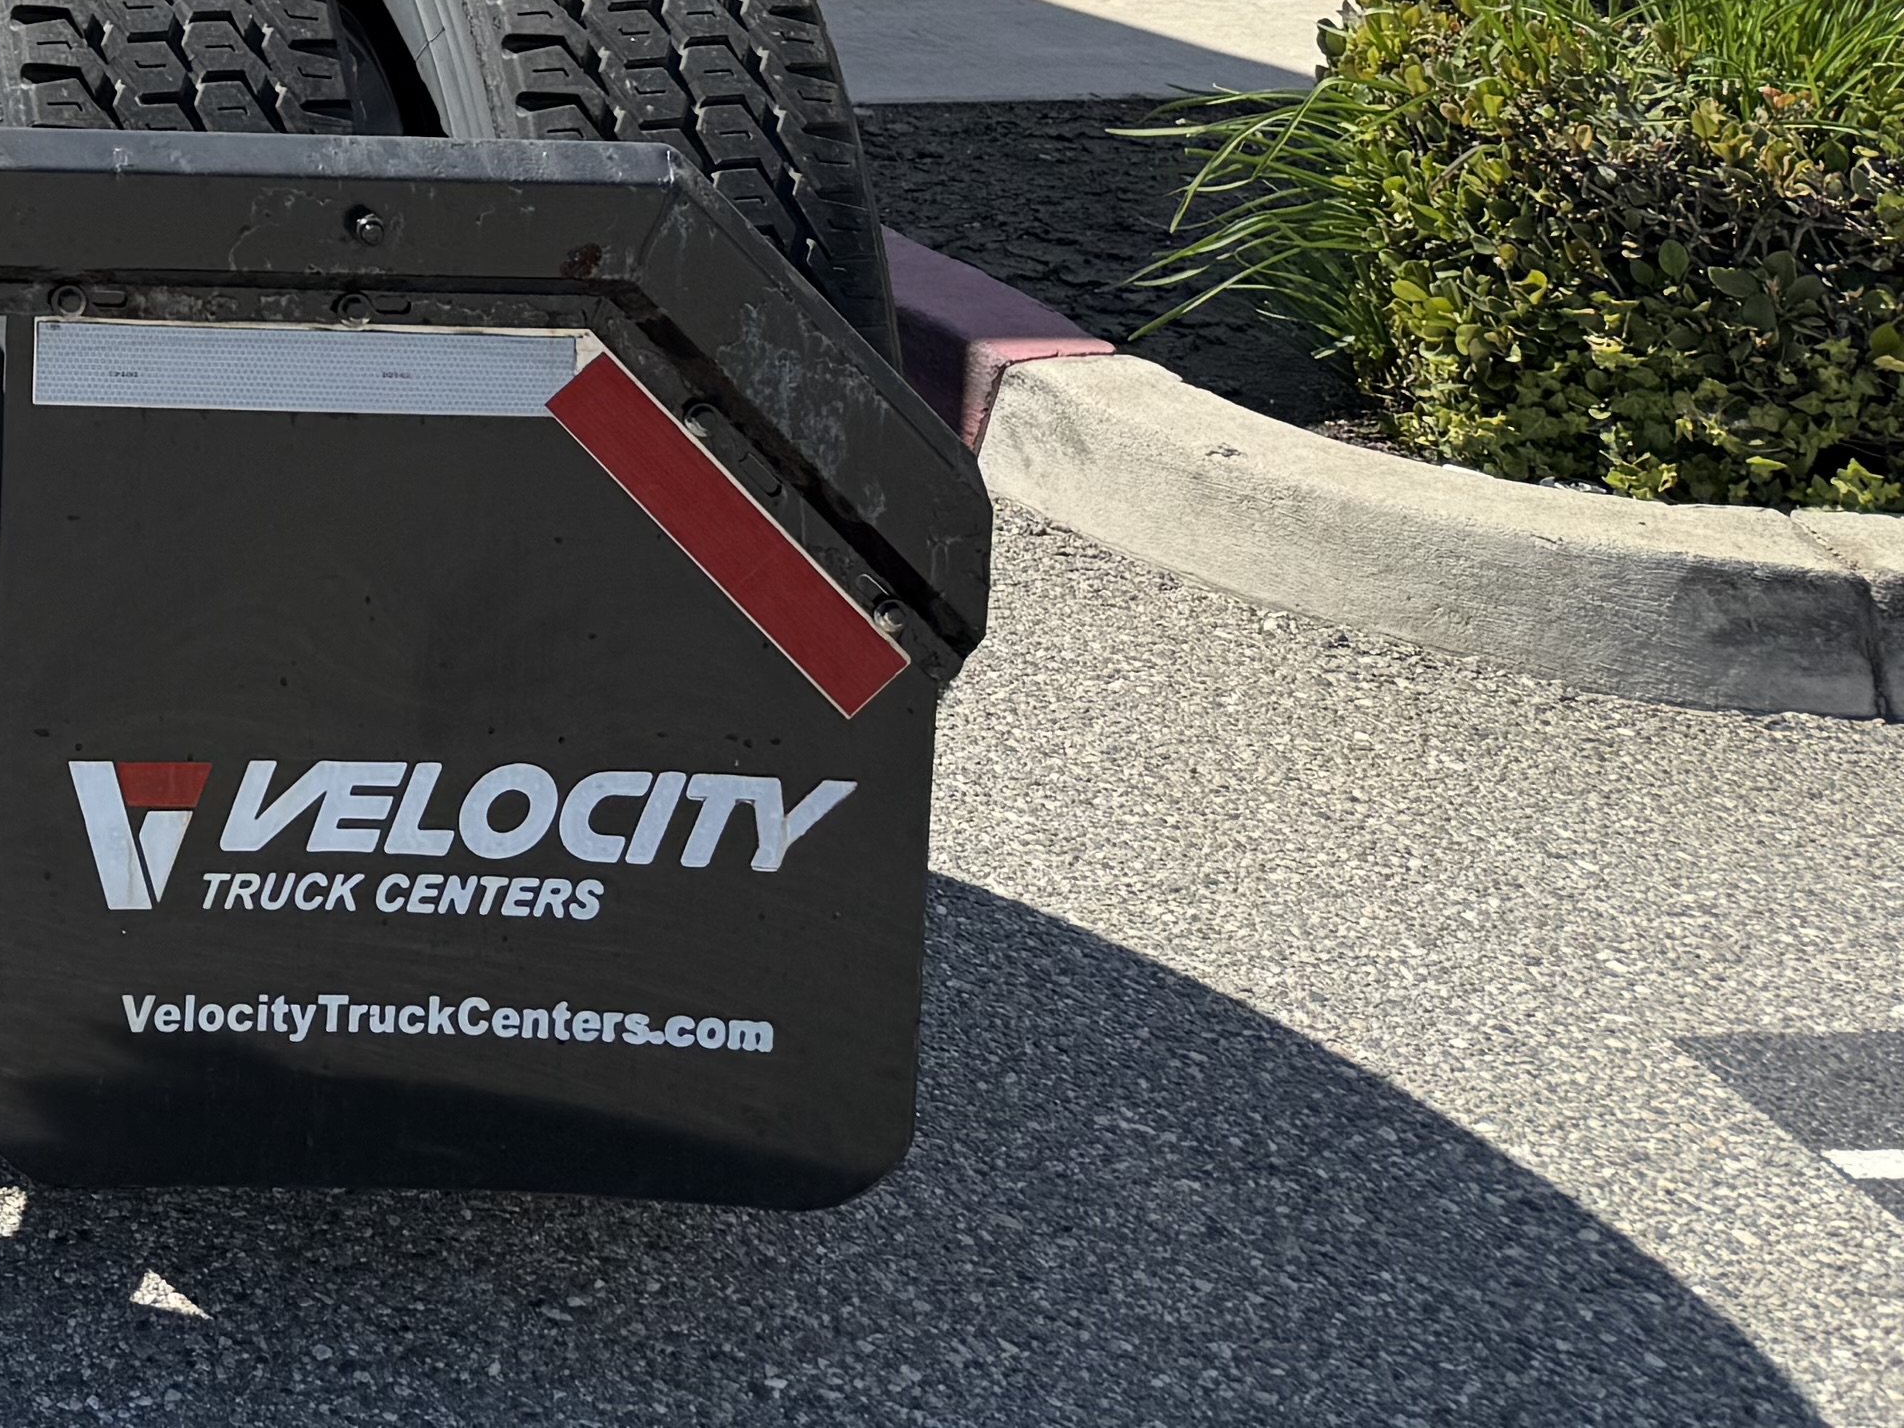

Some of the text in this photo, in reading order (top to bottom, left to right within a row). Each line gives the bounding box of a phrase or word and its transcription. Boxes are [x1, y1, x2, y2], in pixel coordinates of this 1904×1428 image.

[219, 760, 858, 873] VELOCITY
[202, 872, 605, 921] TRUCK CENTERS
[121, 994, 775, 1054] VelocityTruckCenters.com
